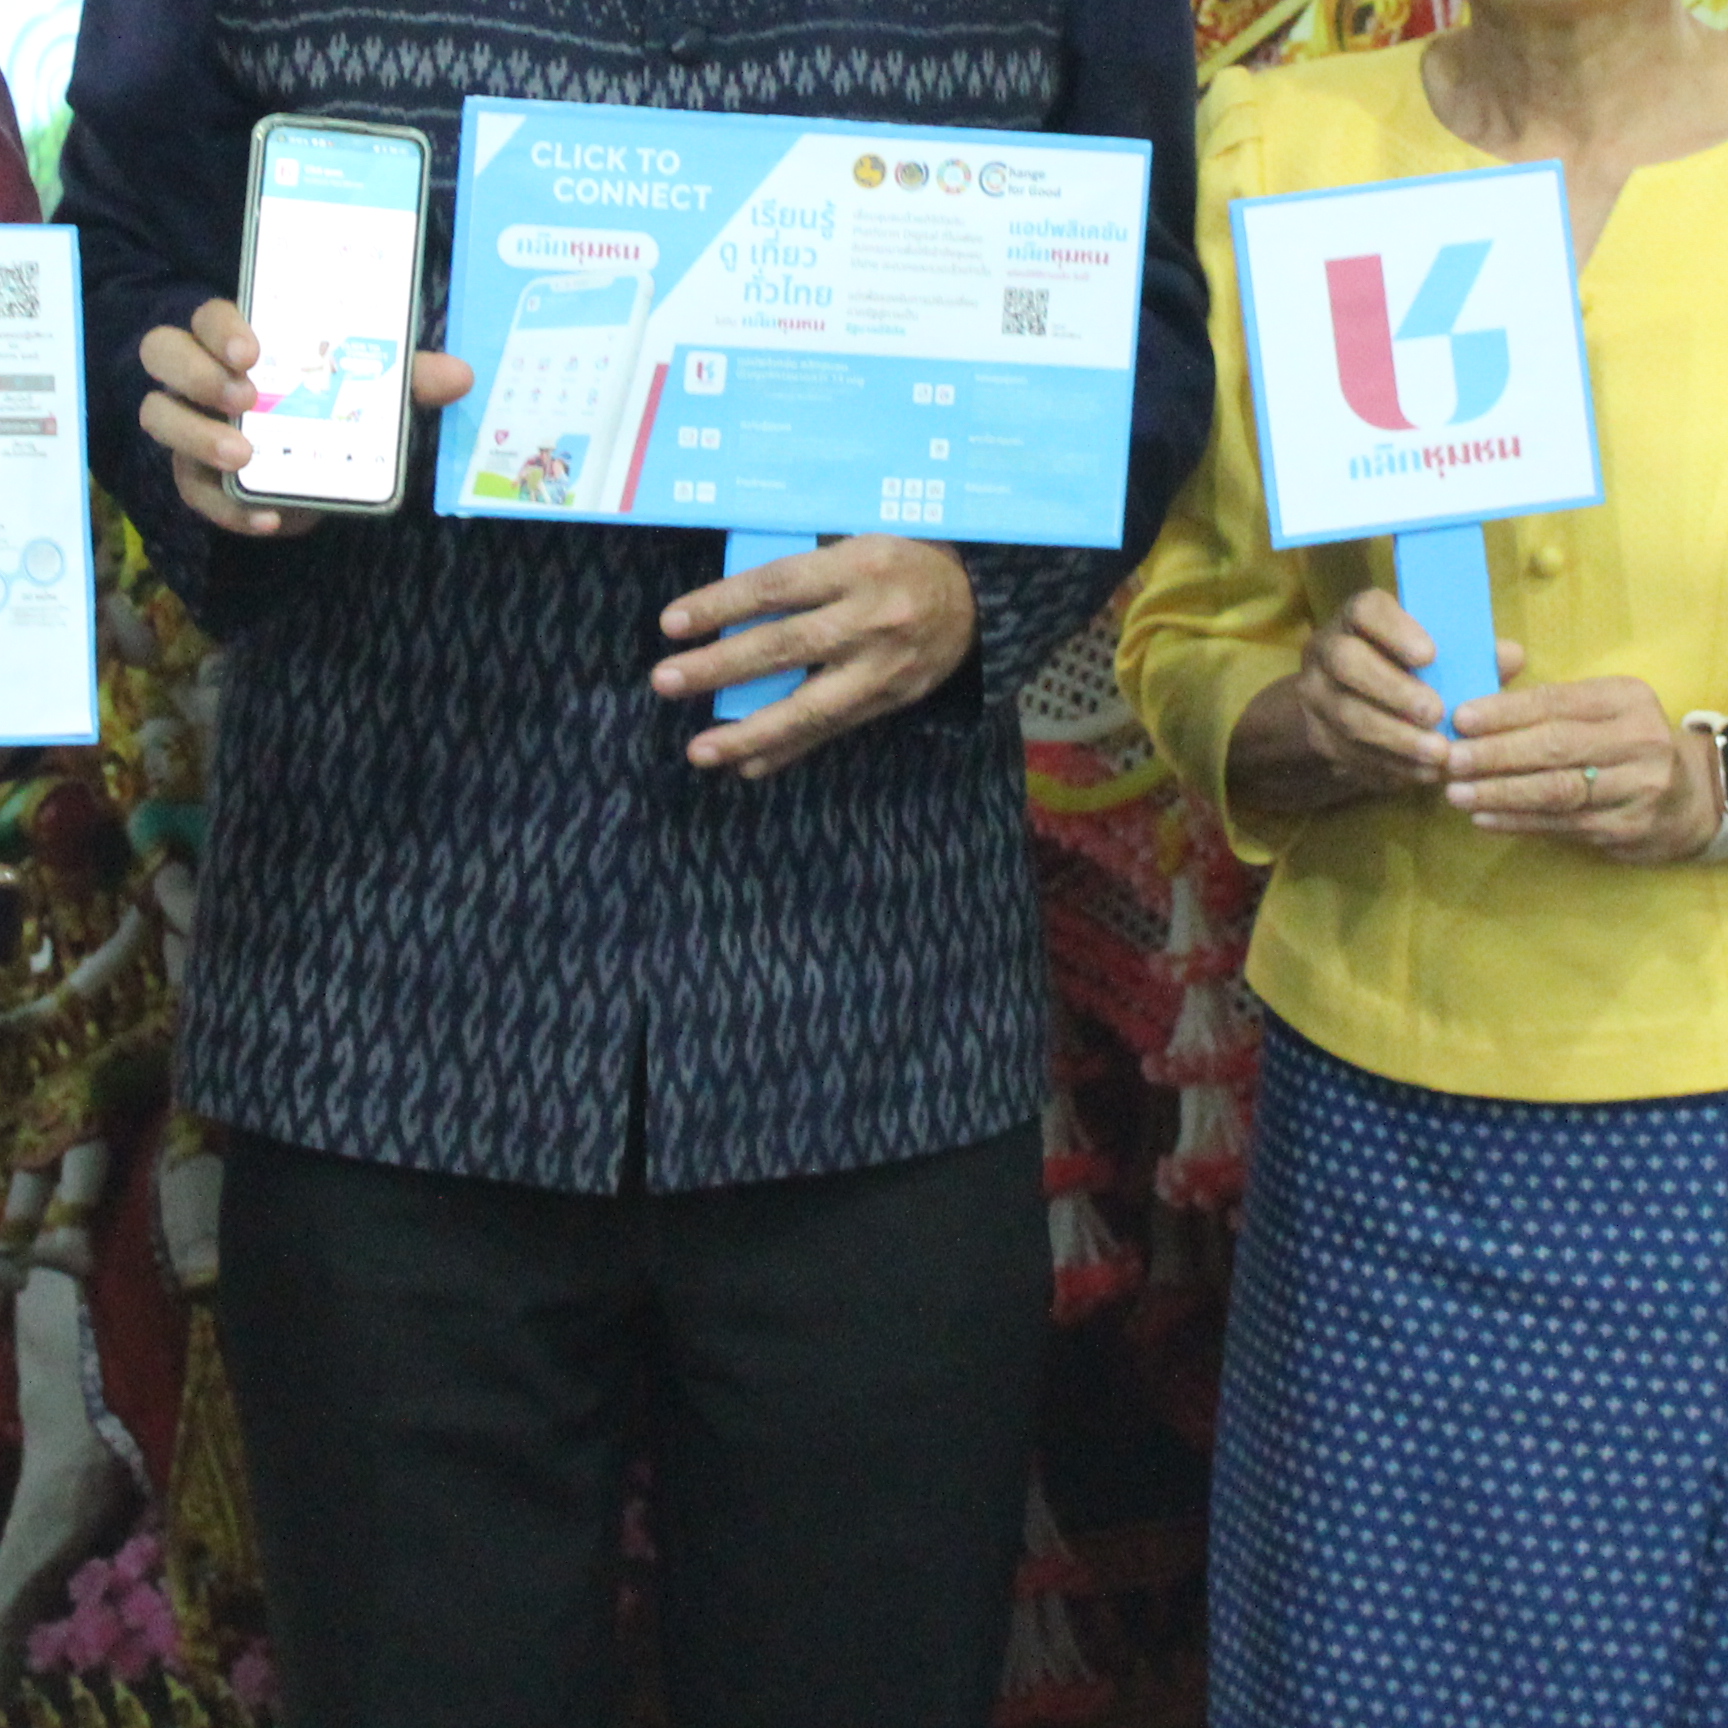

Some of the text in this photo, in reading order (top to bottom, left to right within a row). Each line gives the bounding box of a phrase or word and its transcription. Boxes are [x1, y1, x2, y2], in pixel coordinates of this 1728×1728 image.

[530, 140, 681, 176] CLICK TO
[553, 176, 713, 212] CONNECT
[751, 198, 836, 241] เรียนรู้
[720, 241, 738, 273] ดู
[751, 229, 817, 269] เที่ยว
[744, 267, 833, 308] ทั่วไทย
